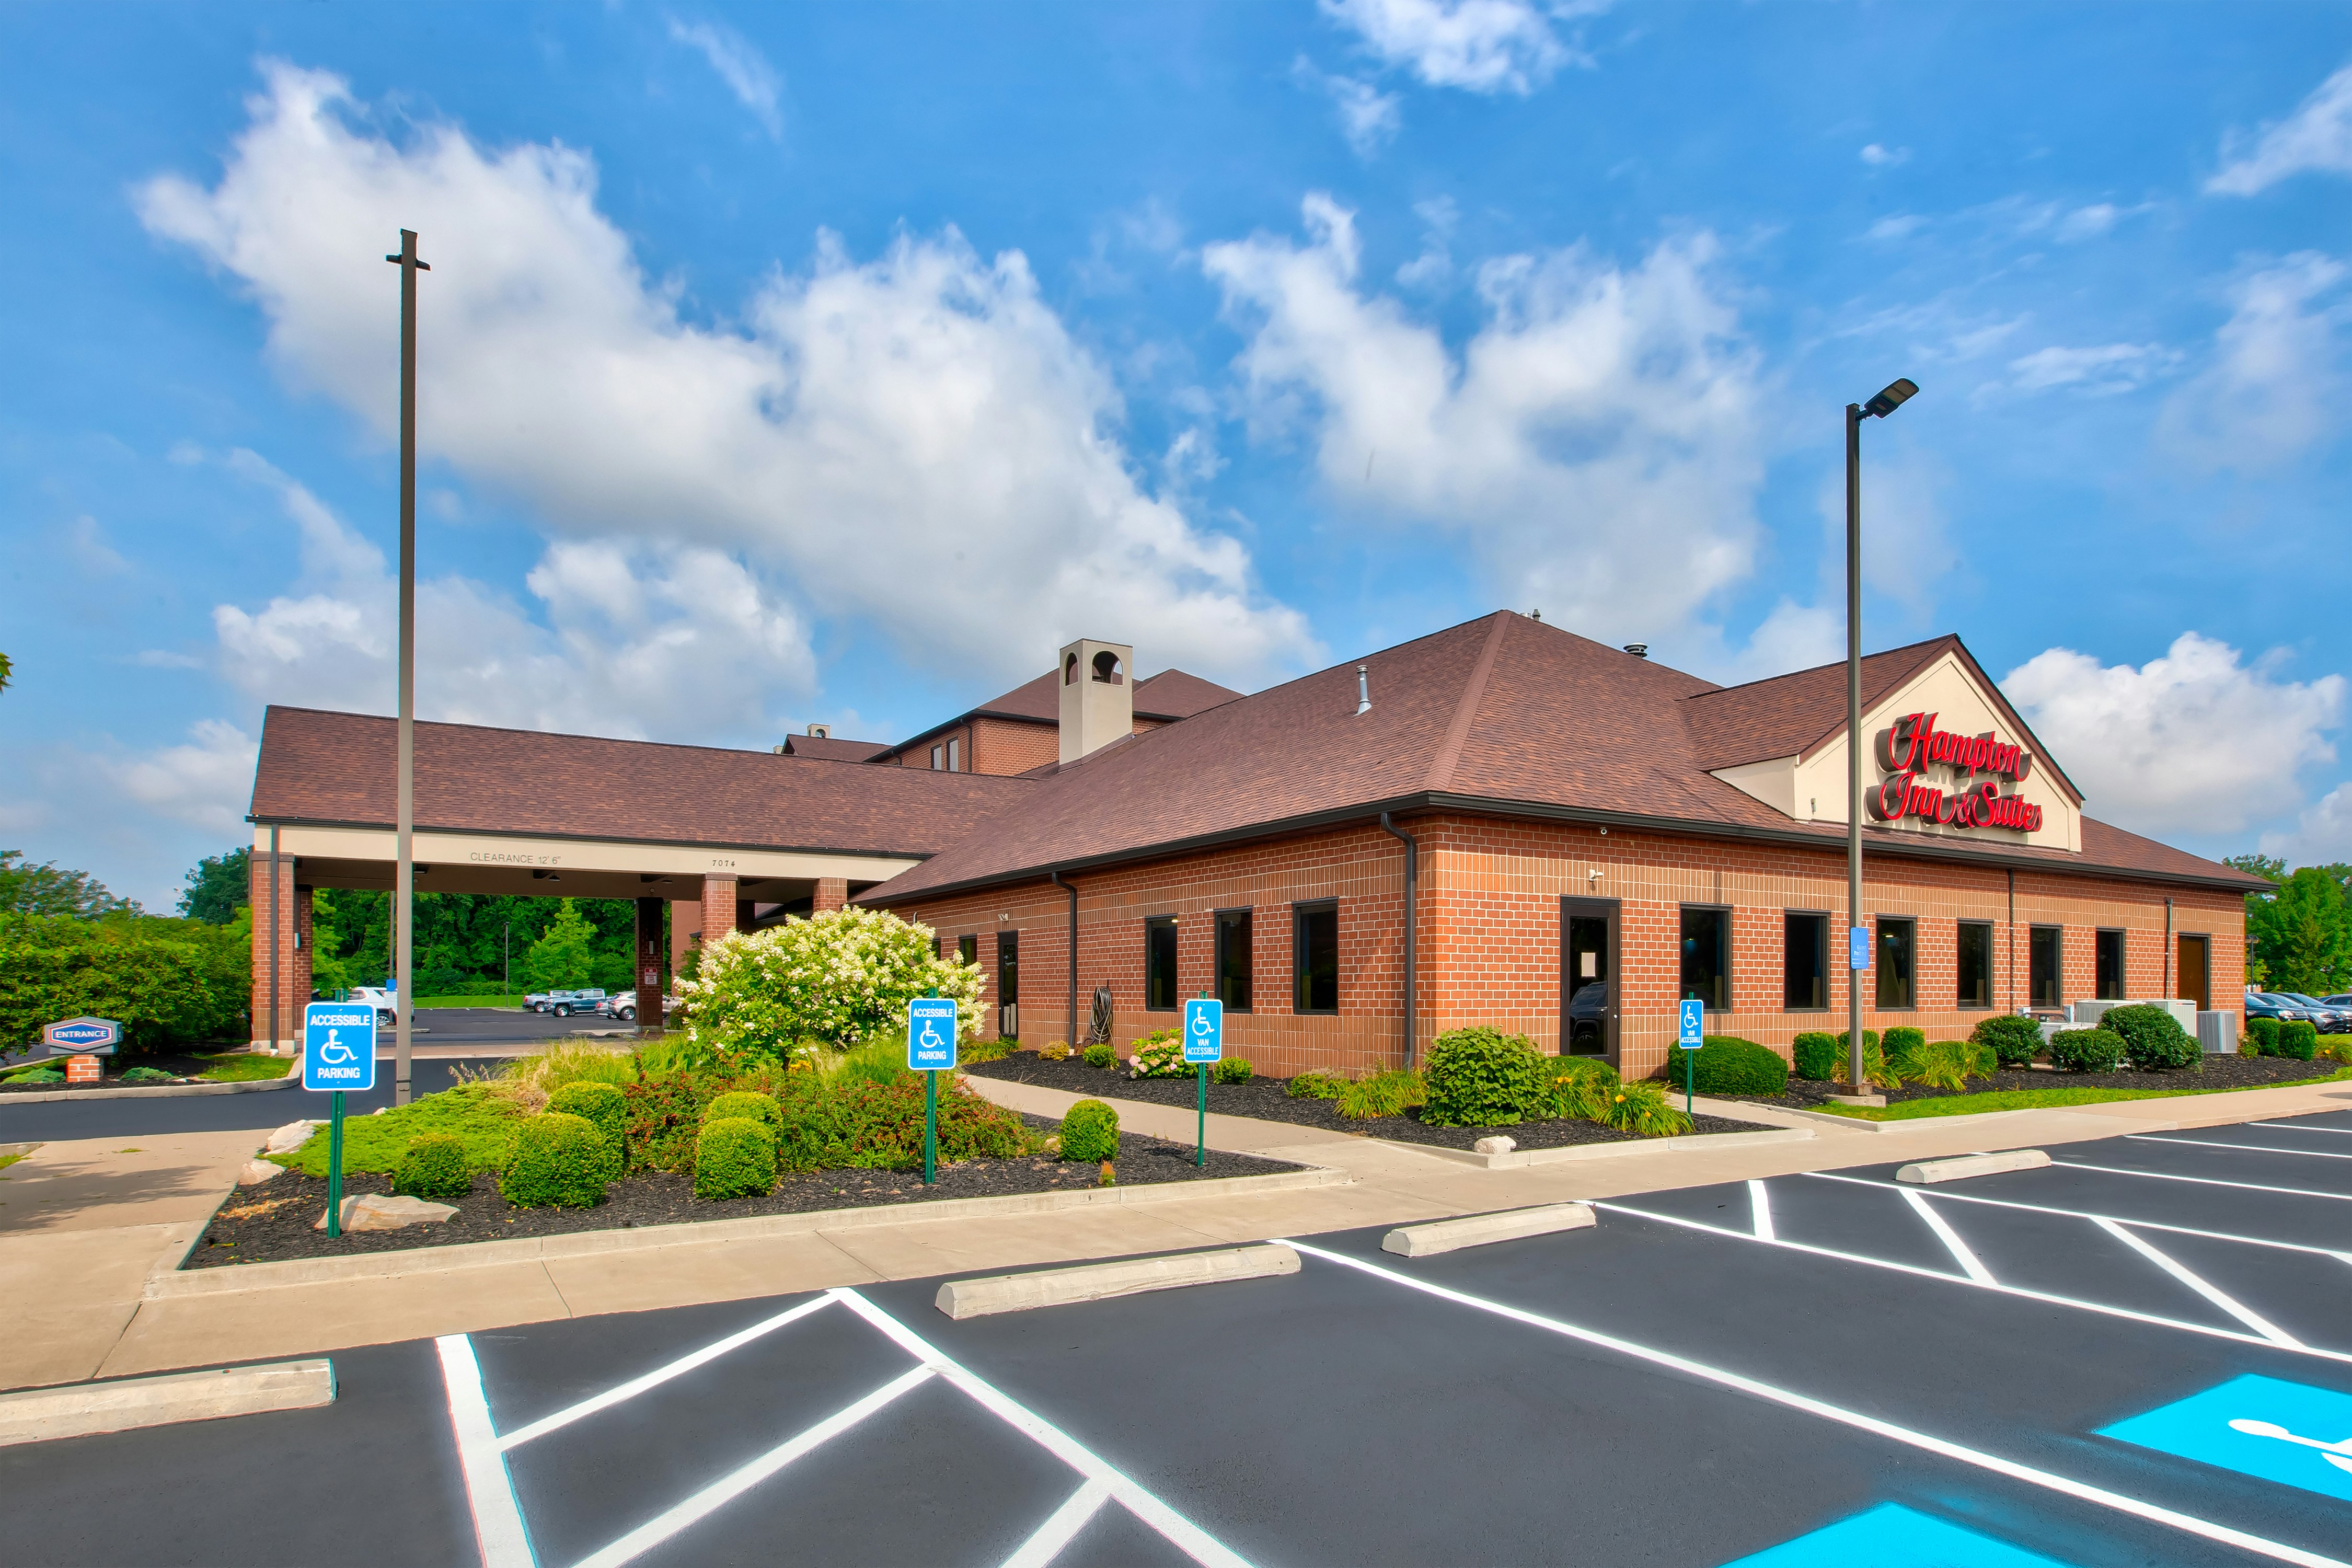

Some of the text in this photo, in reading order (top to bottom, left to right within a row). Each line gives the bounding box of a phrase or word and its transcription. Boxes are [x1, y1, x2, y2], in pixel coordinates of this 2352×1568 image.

[1888, 711, 2032, 782] Hampton
[1881, 771, 2043, 832] Inn & Suites
[470, 852, 534, 863] CLEARANCE
[913, 1008, 953, 1018] ACCESSIBLE
[309, 1014, 371, 1026] ACCESSIBLE
[1197, 1038, 1209, 1046] VAN
[918, 1050, 947, 1060] PARKING
[1186, 1047, 1219, 1055] ACCESSIBLE
[317, 1067, 361, 1079] PARKING
